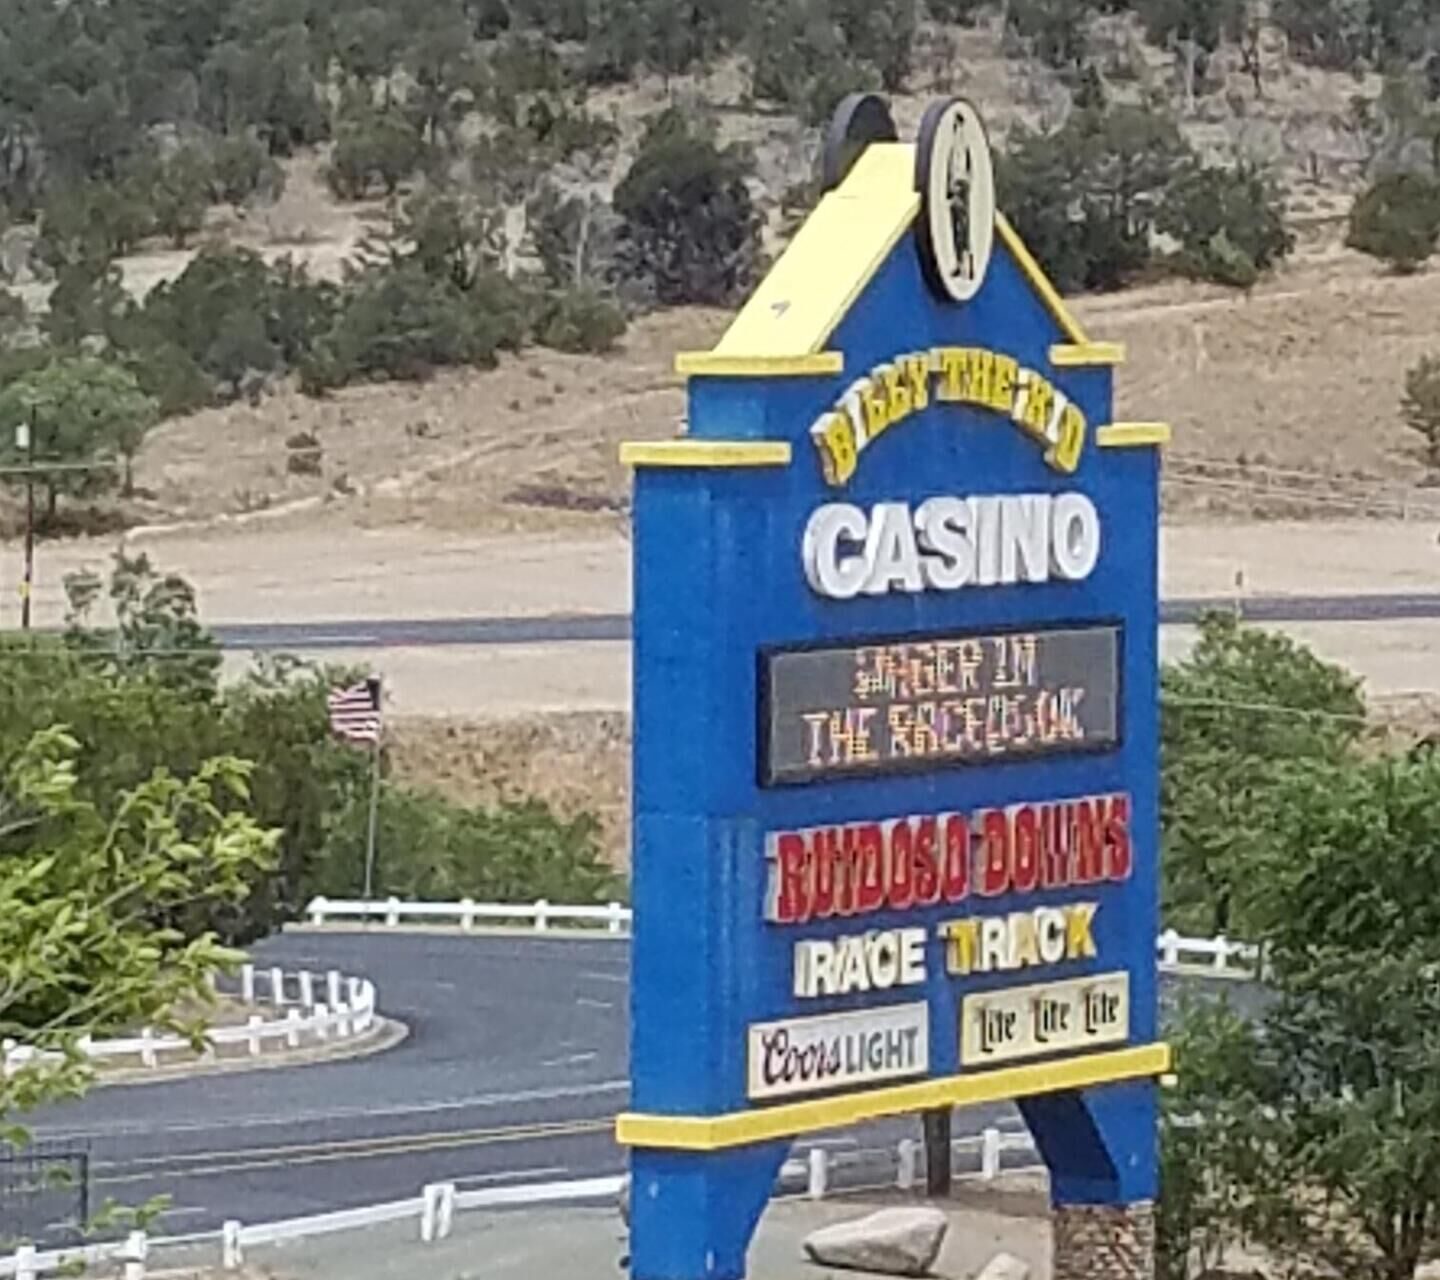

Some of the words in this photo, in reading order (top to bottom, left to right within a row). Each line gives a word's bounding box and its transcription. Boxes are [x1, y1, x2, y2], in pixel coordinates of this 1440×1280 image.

[809, 351, 929, 486] BILLY
[927, 347, 1019, 412] THE
[1011, 367, 1087, 472] KID
[804, 492, 1100, 598] CASINO
[802, 707, 880, 766] THE
[971, 792, 1133, 897] DOWNS
[793, 927, 928, 998] RACE
[937, 902, 1099, 975] TRACK
[761, 1028, 842, 1086] Coors
[846, 1026, 920, 1073] LIGHT
[976, 1006, 1016, 1054] Lite
[1032, 998, 1071, 1044] Lite
[1084, 987, 1120, 1035] Lite
